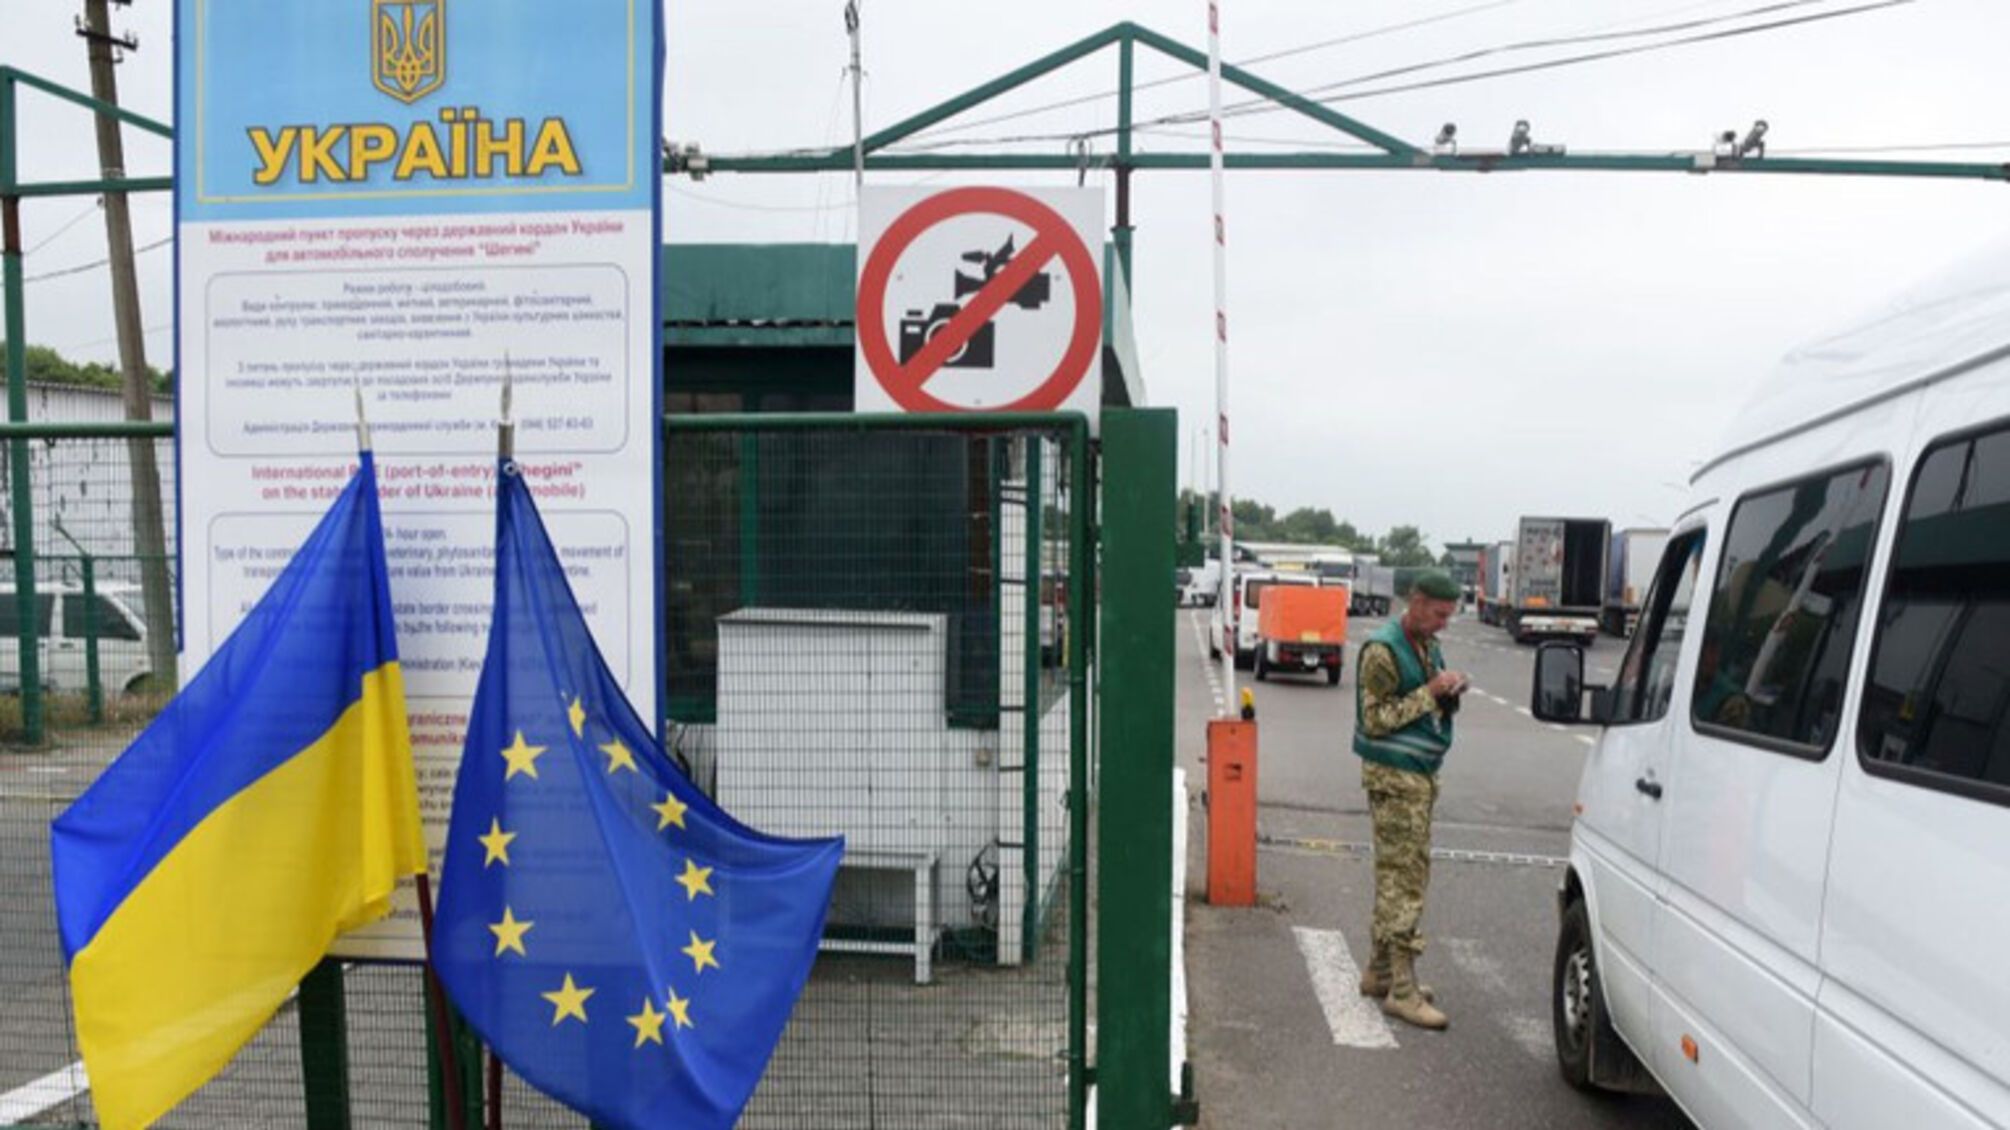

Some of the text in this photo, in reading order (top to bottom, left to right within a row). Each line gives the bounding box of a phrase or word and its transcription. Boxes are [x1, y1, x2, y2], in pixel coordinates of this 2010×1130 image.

[247, 108, 583, 184] УКРАЇНА
[338, 226, 398, 243] пропуску
[402, 226, 439, 241] через
[521, 223, 567, 238] кордон
[571, 219, 624, 237] України
[252, 465, 345, 480] International
[262, 487, 280, 499] on
[283, 485, 308, 499] the
[311, 486, 340, 499] stat
[405, 484, 421, 498] of
[424, 483, 483, 498] Ukraine
